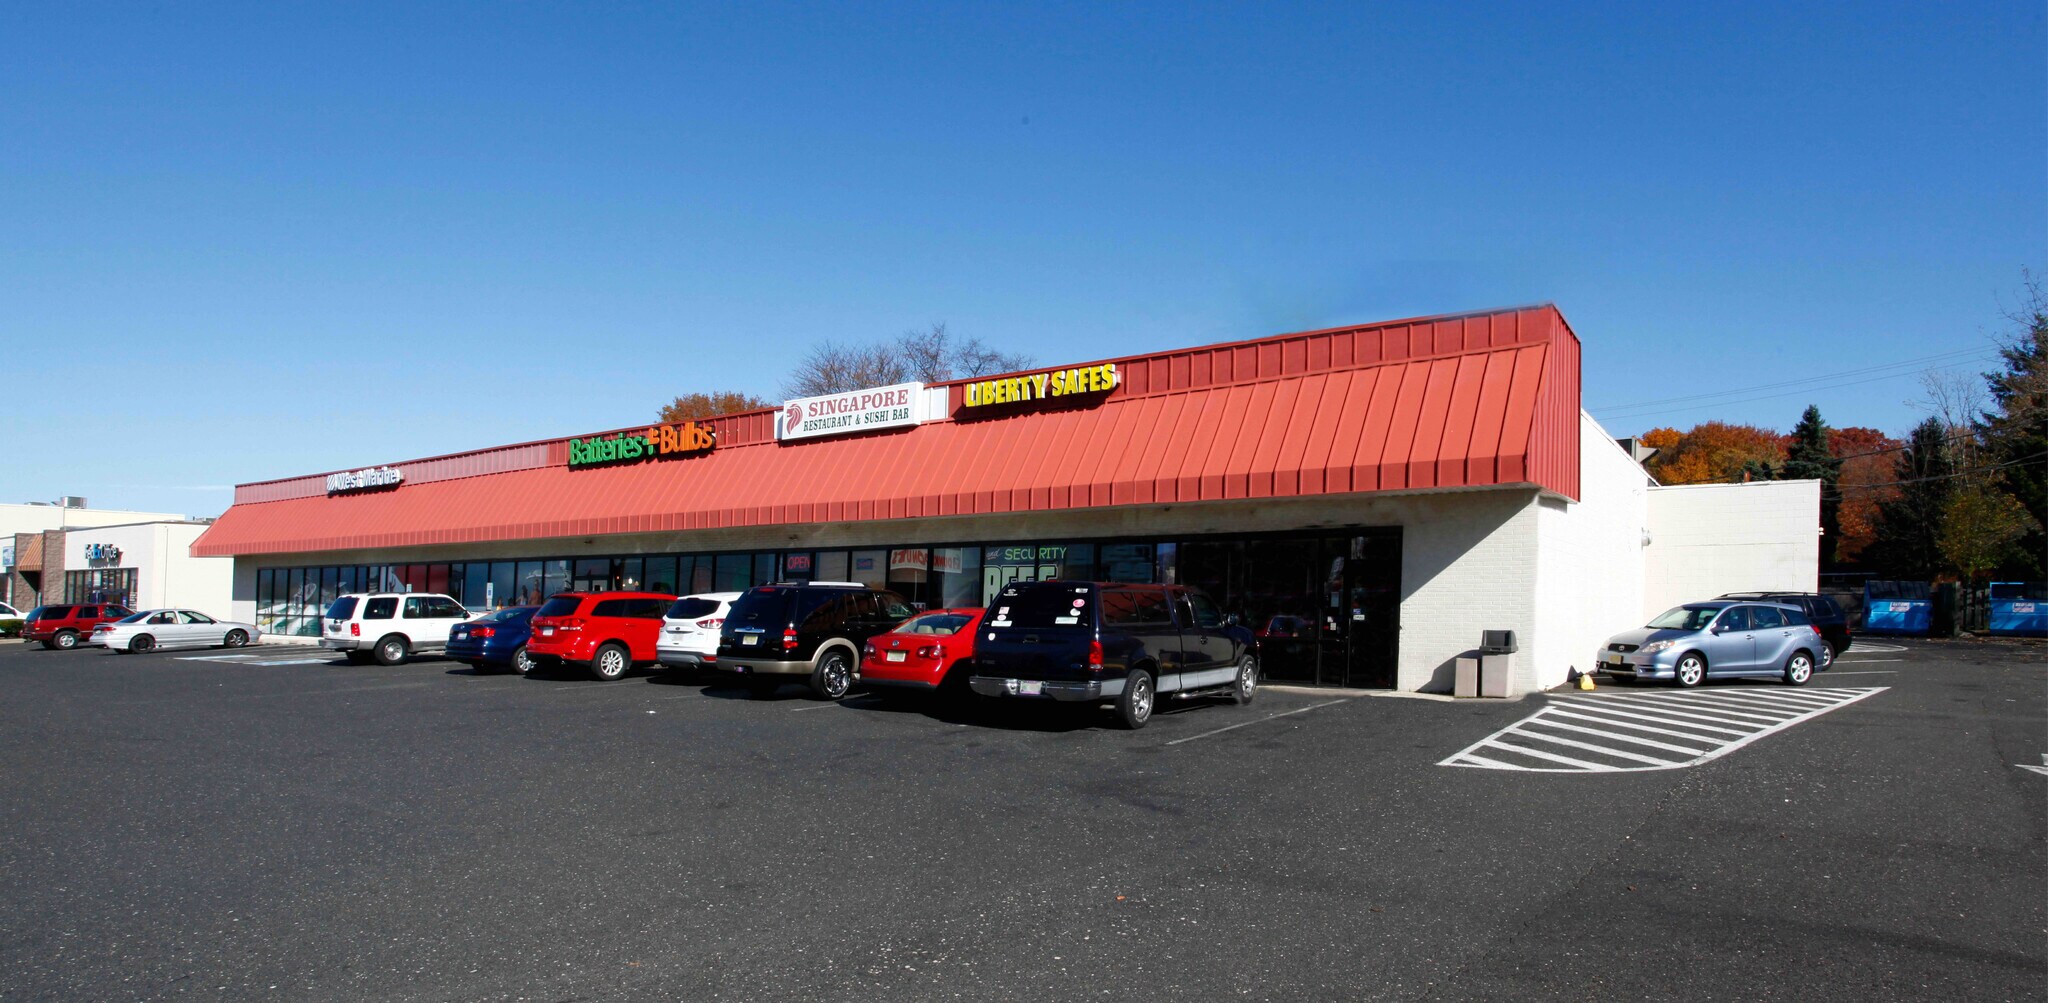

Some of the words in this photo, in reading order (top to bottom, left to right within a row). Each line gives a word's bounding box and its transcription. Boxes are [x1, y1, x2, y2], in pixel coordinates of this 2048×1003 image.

[966, 373, 1049, 408] LIBERTY
[1051, 363, 1115, 397] SAFES
[808, 389, 909, 418] SINGAPORE
[803, 414, 852, 432] RESTAURANT
[855, 414, 861, 425] &
[864, 410, 889, 424] SUSHI
[892, 407, 909, 421] BAR
[569, 432, 643, 465] Batteries
[660, 421, 713, 455] Bulbs
[787, 556, 811, 570] OPEN
[1004, 546, 1067, 561] SECURITY
